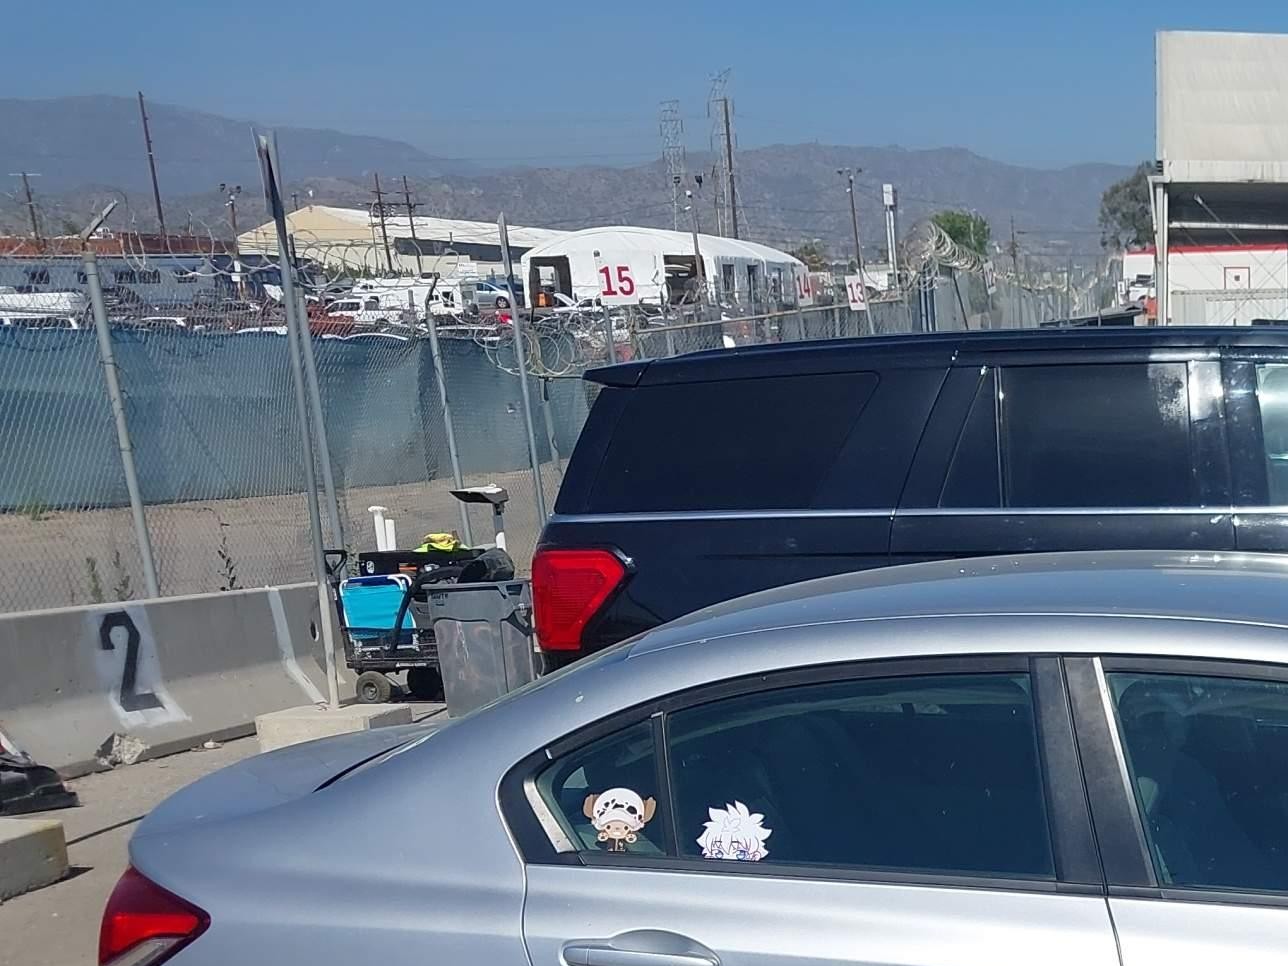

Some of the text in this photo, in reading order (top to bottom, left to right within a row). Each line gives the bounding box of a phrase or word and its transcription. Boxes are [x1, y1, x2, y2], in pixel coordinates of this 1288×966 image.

[600, 265, 635, 297] 15
[797, 273, 811, 299] 14
[848, 282, 865, 304] 13
[99, 608, 166, 713] 2
